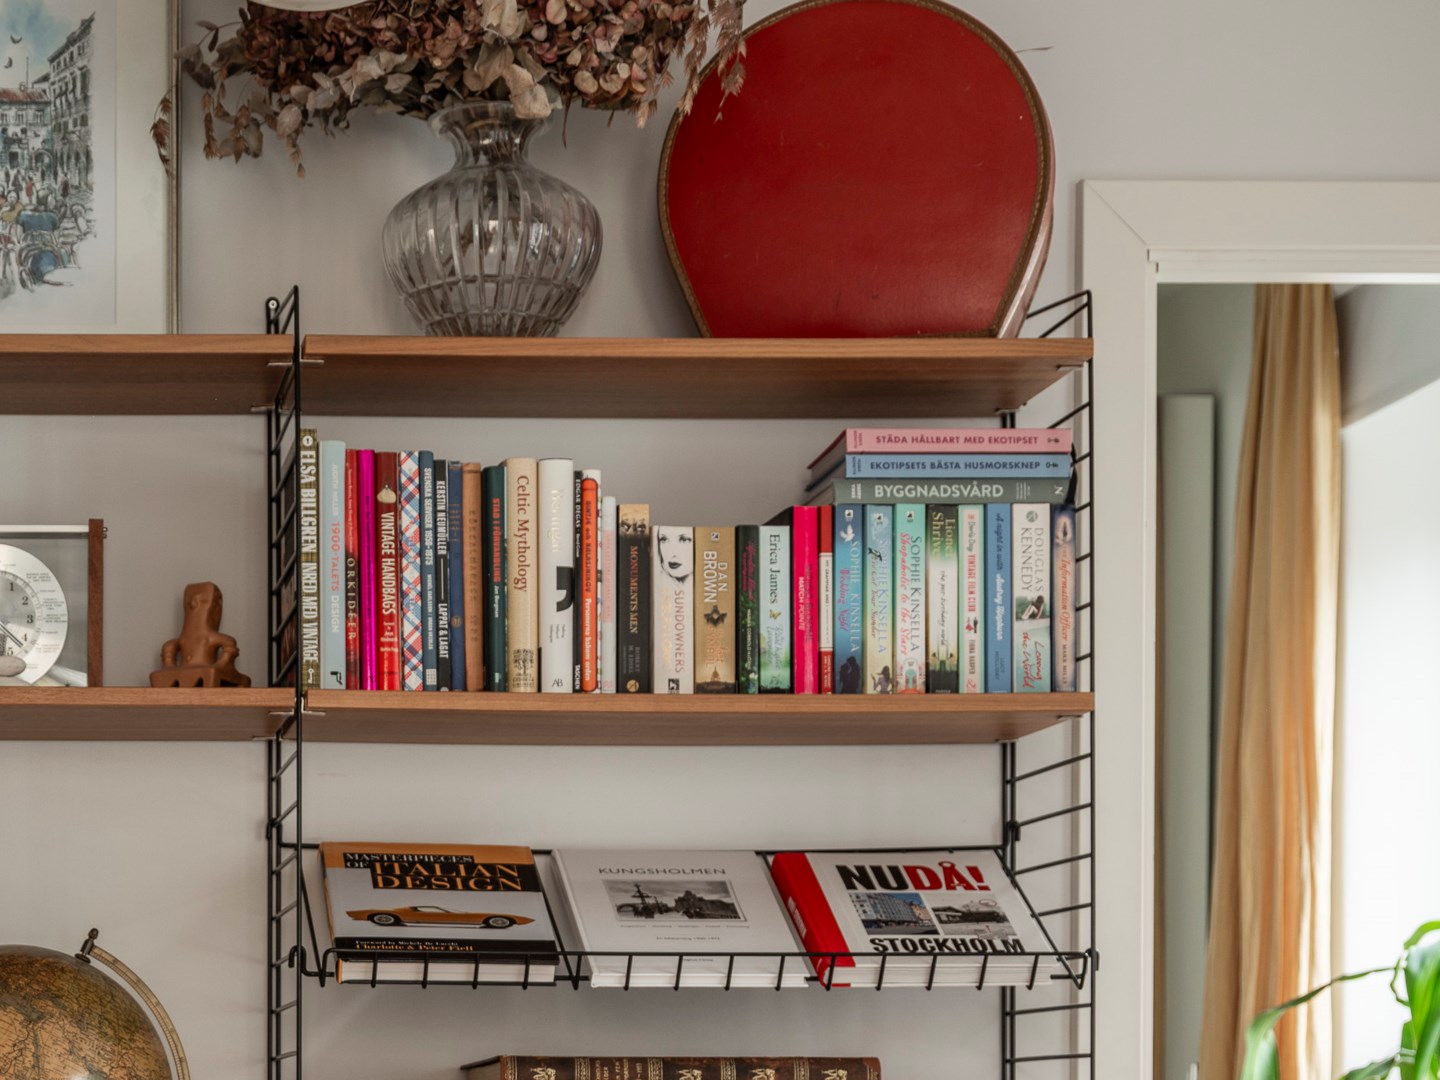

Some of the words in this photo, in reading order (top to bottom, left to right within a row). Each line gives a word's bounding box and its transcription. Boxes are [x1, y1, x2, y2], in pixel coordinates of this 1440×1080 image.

[876, 435, 908, 444] STÄDA
[912, 434, 960, 444] HÅLLBART
[964, 436, 985, 444] MED
[988, 436, 1038, 444] EKOTIPSET
[300, 450, 316, 483] ELSA
[930, 460, 960, 469] BÄSTA
[436, 480, 447, 510] KERSTIN
[516, 475, 530, 515] Celtic
[874, 481, 1003, 498] BYGGNADSVÅRD
[300, 488, 317, 552] BILLGREN
[381, 512, 395, 554] VINTAGE
[437, 512, 448, 555] NEUMÜLLER
[331, 522, 341, 591] 1900-TALETS
[513, 520, 530, 592] Mythology
[770, 534, 780, 564] Erica
[851, 541, 860, 584] SOPHIE
[910, 536, 921, 582] SOPHIE
[1021, 527, 1032, 593] KENNEDY
[1034, 527, 1044, 592] DOUGLAS
[302, 562, 317, 593] INRED
[381, 558, 396, 615] HANDBAGS
[630, 546, 638, 612] MONUMENTS
[704, 551, 717, 602] BROWN
[718, 562, 728, 591] DAN
[769, 568, 780, 604] James
[22, 596, 29, 605] 2
[302, 596, 317, 620] MED
[331, 595, 340, 633] DESIGN
[346, 558, 358, 640] ORKIDÉER
[438, 603, 448, 628] LAPPAT
[27, 615, 33, 623] 3
[630, 612, 638, 634] MEN
[674, 590, 685, 673] SUNDOWNERS
[850, 594, 860, 652] KINSELLA
[910, 587, 921, 651] KINSELLA
[1062, 611, 1070, 640] Officer
[302, 622, 318, 663] VINTAGE
[346, 853, 473, 863] MASTERPIECES
[375, 862, 519, 877] ITALIAN
[597, 867, 727, 876] KUNGSHOLMEN
[377, 876, 522, 891] DESIGN
[835, 861, 991, 891] NUDÅ!
[869, 938, 1026, 953] STOCKHOLM
